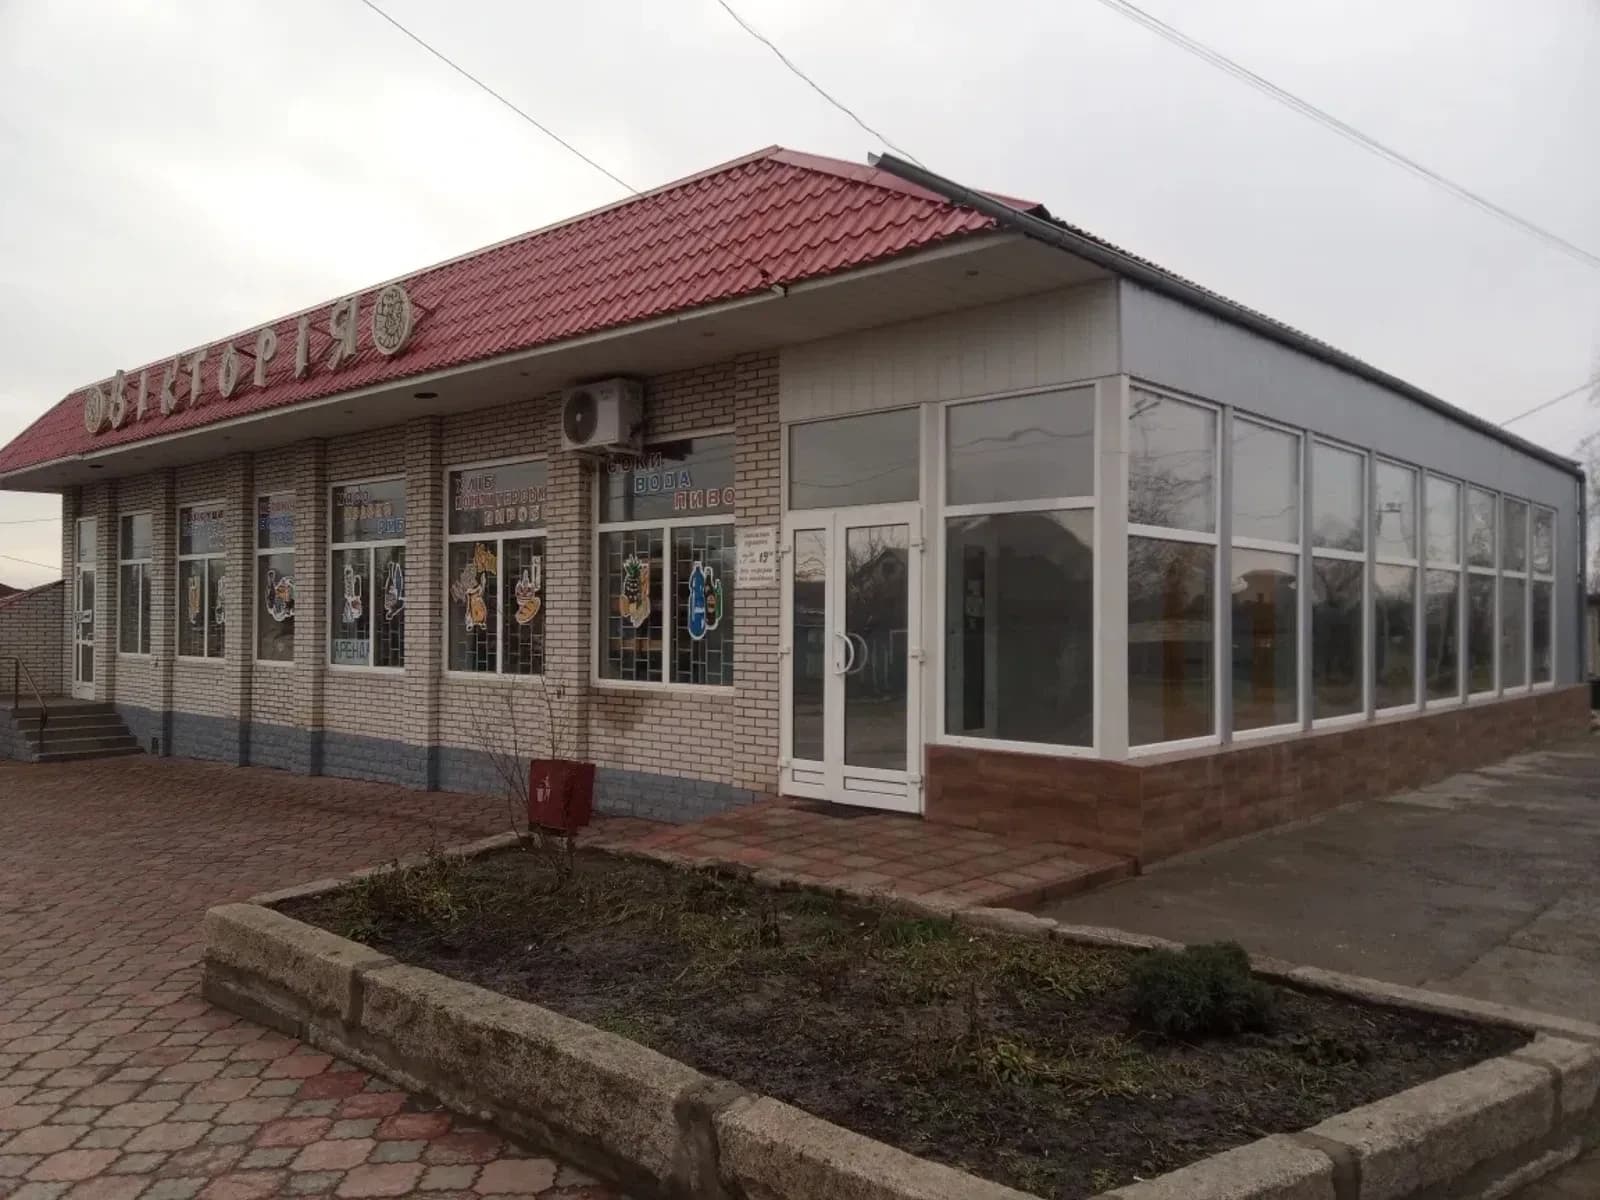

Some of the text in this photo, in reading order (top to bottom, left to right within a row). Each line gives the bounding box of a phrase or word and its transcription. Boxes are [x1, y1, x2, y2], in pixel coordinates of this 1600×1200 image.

[108, 298, 360, 429] ВІКТОРІЯ
[634, 471, 692, 494] ВОДА
[673, 486, 736, 510] ПИВО
